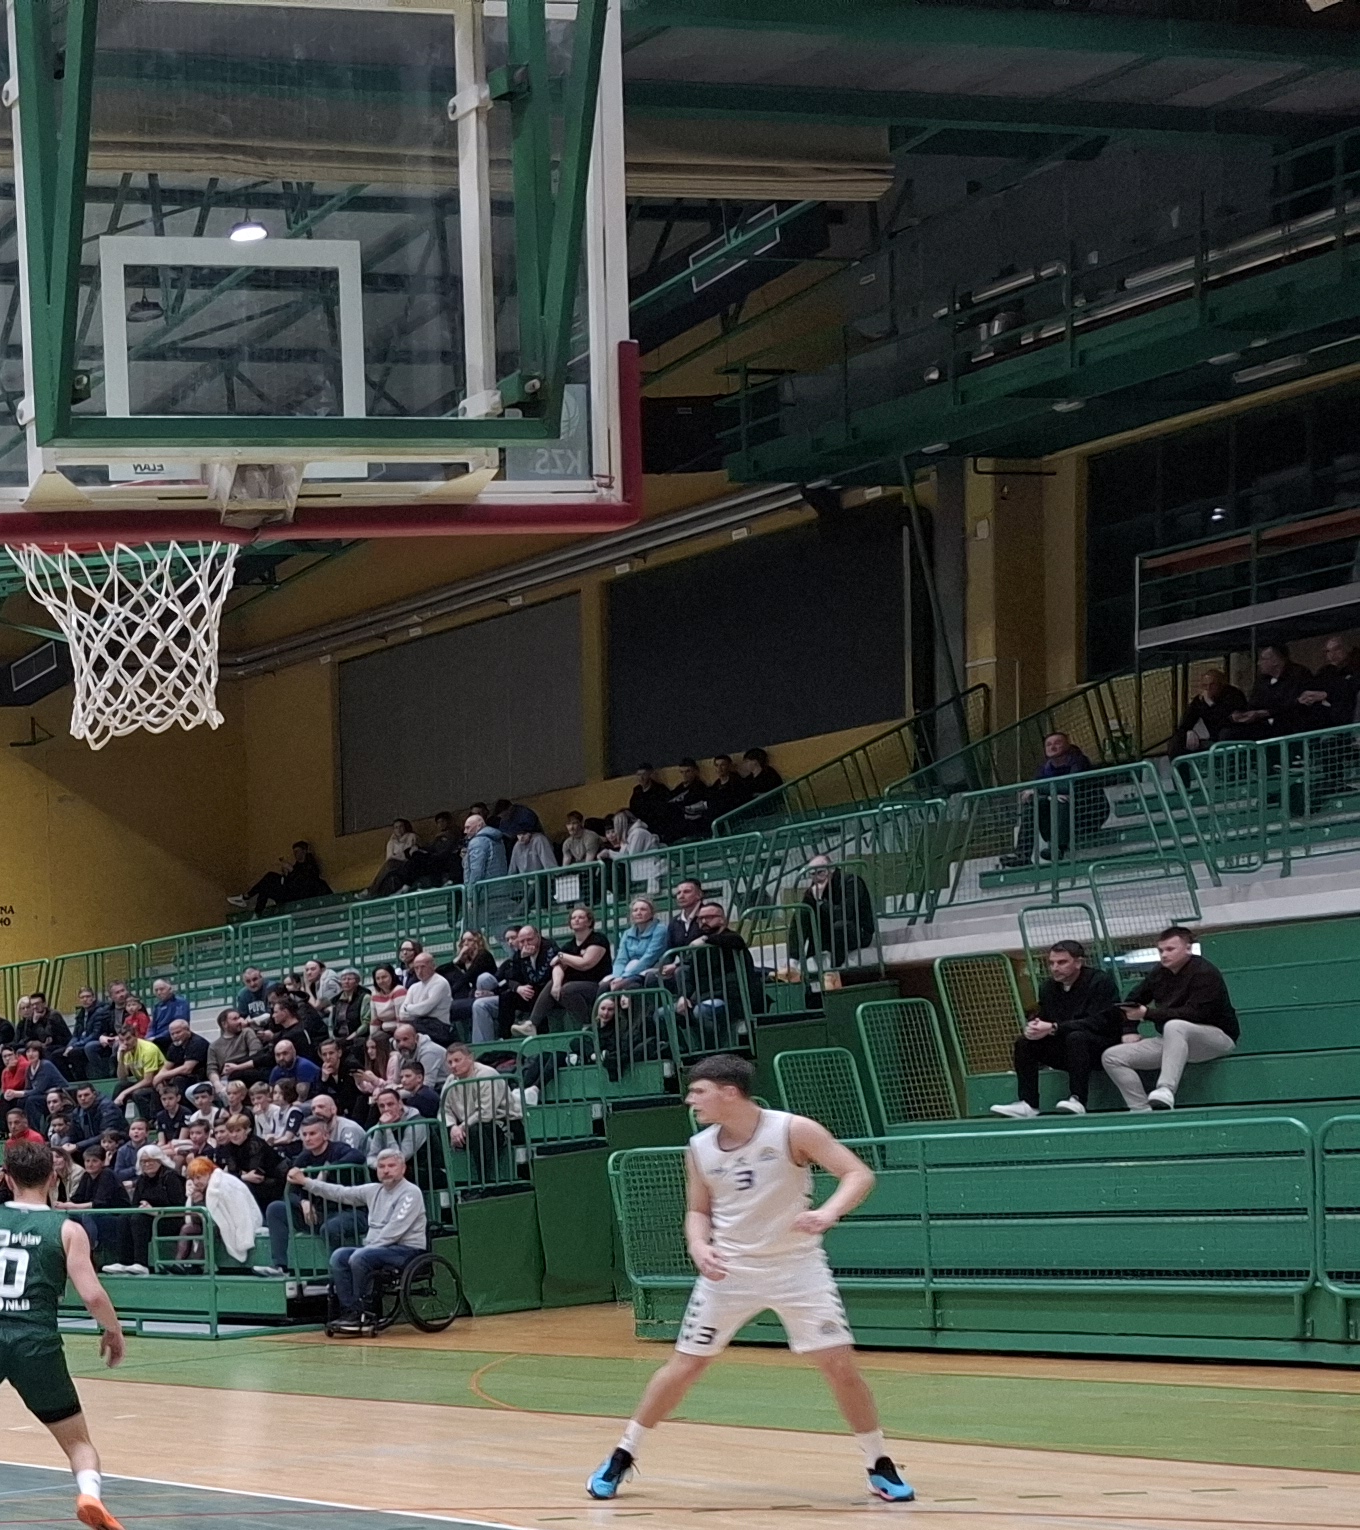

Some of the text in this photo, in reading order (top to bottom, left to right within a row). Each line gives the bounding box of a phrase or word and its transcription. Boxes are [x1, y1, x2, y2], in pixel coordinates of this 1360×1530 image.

[734, 1169, 754, 1191] 3
[5, 1298, 31, 1312] NLB
[695, 1326, 717, 1346] 3
